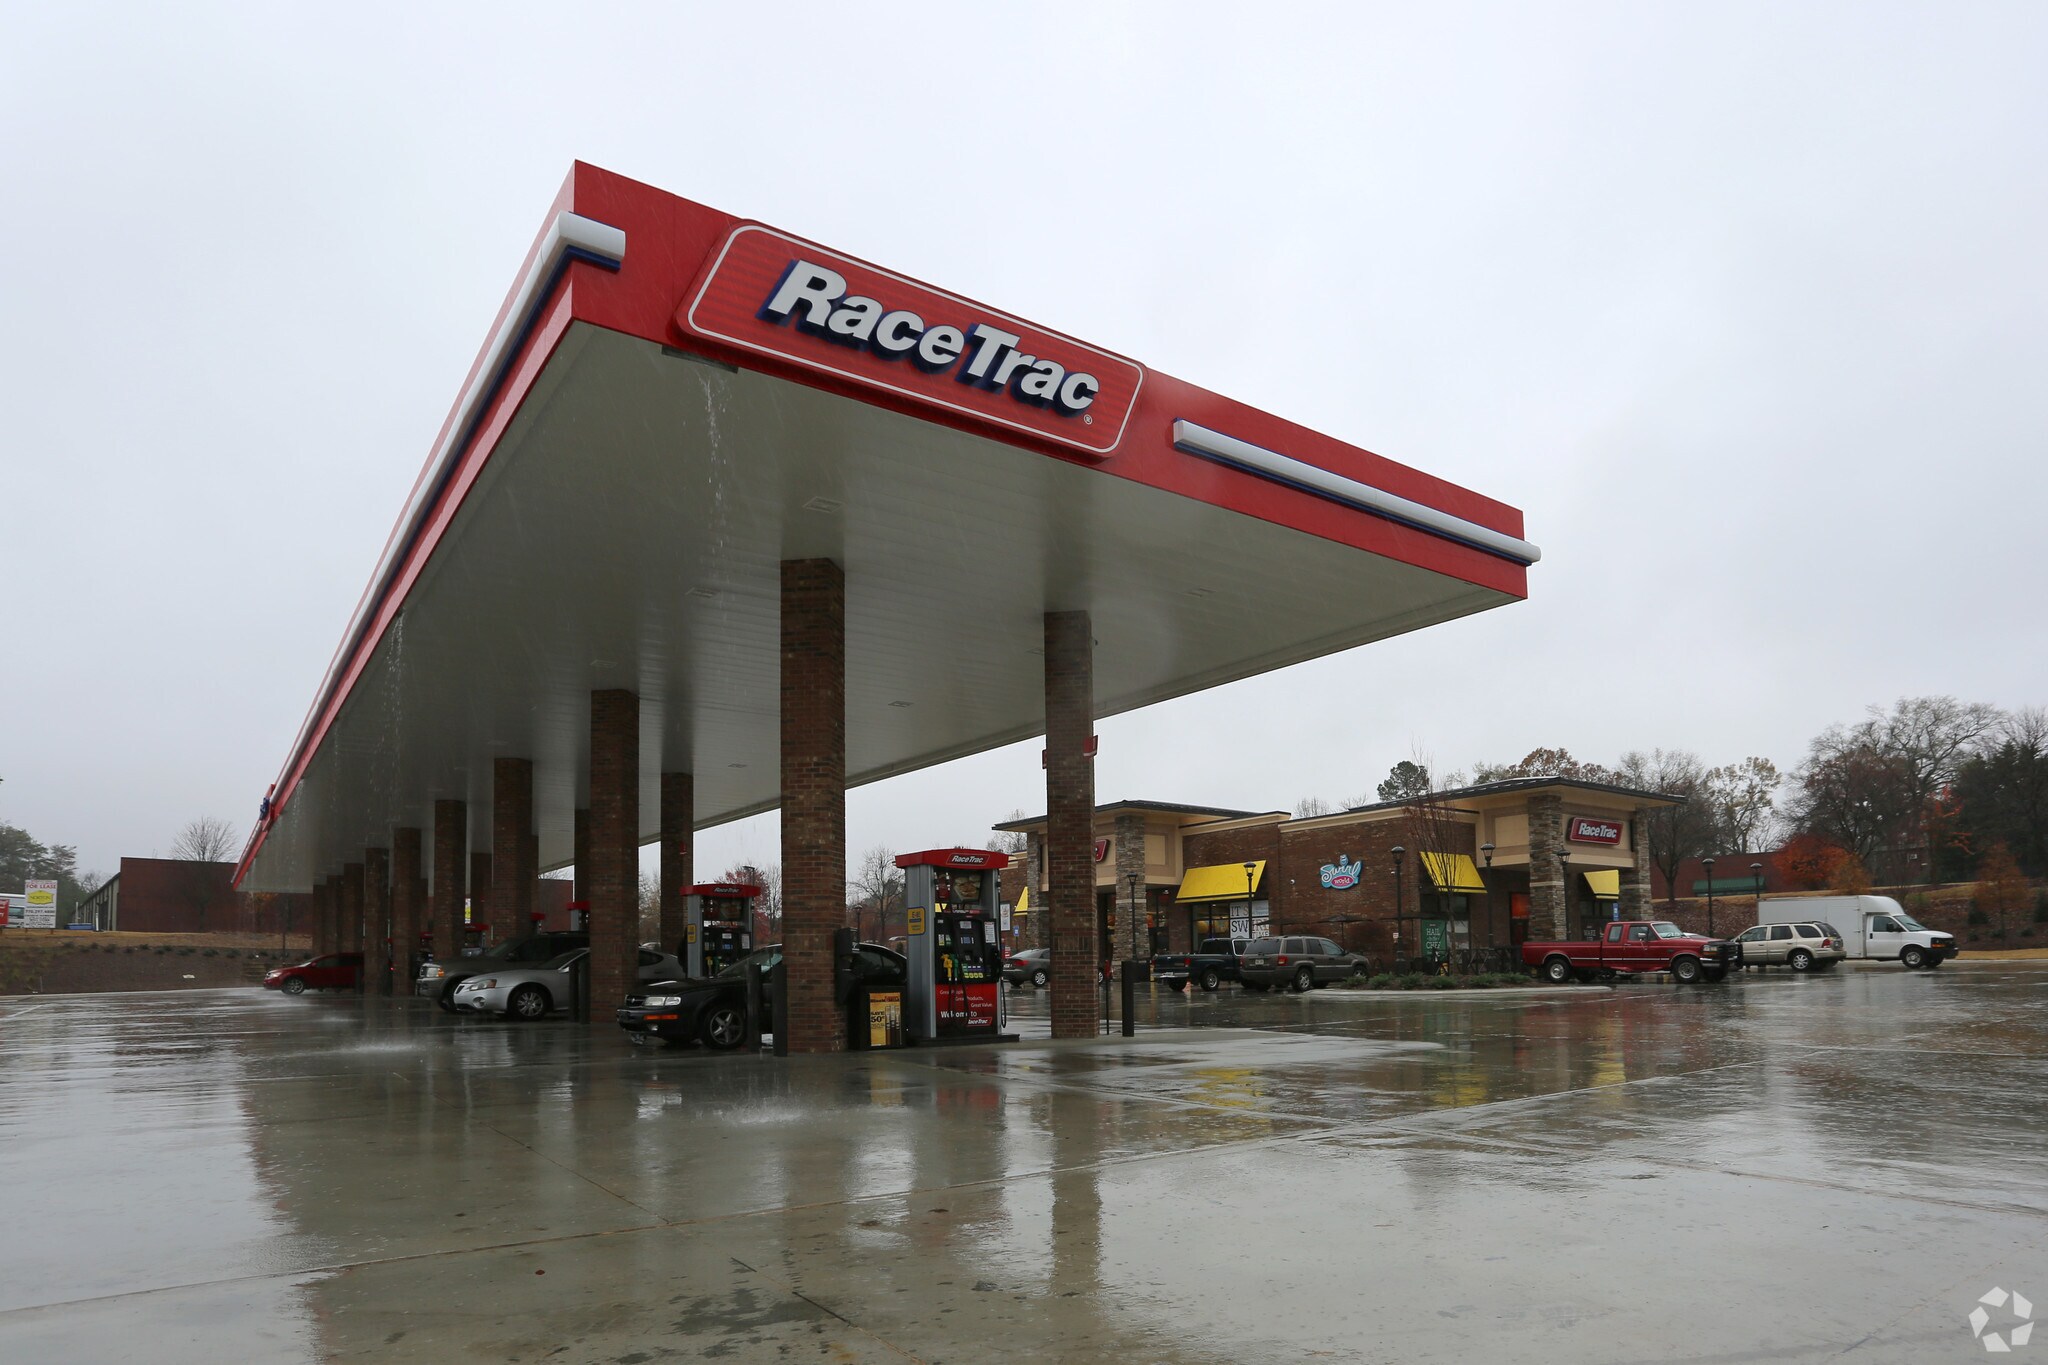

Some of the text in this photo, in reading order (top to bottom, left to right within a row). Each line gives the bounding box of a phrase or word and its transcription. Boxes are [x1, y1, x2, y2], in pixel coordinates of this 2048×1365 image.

[765, 259, 1099, 411] RaceTrac
[1578, 822, 1617, 839] RaceTrac
[952, 855, 984, 863] RaceTrac
[1320, 861, 1361, 883] Swirl
